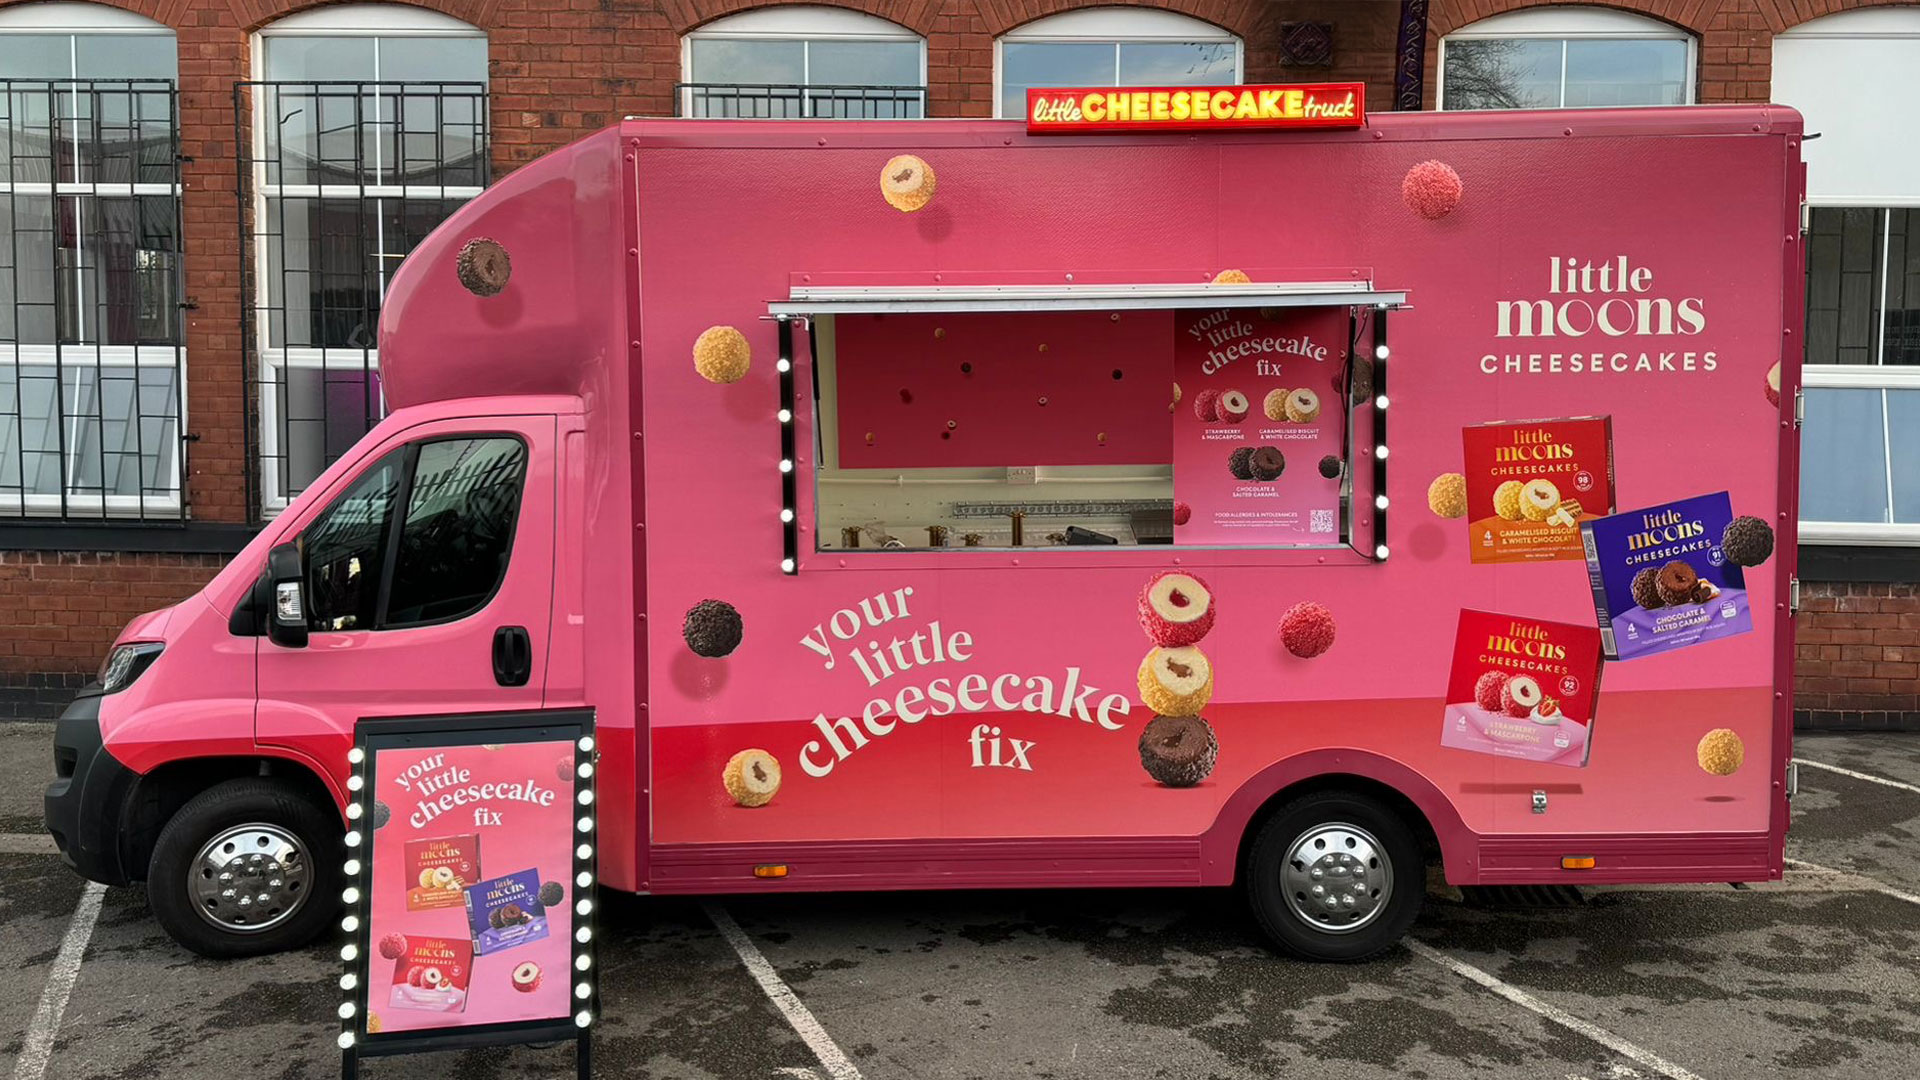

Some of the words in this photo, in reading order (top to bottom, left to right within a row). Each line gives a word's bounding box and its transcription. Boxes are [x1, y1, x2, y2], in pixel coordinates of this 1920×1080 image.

[1033, 97, 1082, 122] little
[1082, 90, 1304, 122] CHEESECAKE
[1304, 92, 1354, 119] truck
[1549, 255, 1652, 293] little
[1188, 308, 1230, 341] your
[1494, 298, 1706, 337] moons
[1207, 321, 1253, 348] little
[1201, 336, 1328, 375] cheesecake
[1256, 359, 1282, 376] fix
[1480, 352, 1717, 374] CHEESECAKES
[1513, 429, 1552, 445] little
[1495, 443, 1574, 462] moons
[1490, 463, 1579, 476] CHEESECAKES
[1642, 509, 1682, 530] little
[1484, 530, 1492, 540] 4
[1500, 528, 1549, 537] CARAMELISED
[1627, 520, 1704, 551] moons
[1625, 538, 1712, 565] CHEESECAKES
[799, 586, 914, 670] your
[1628, 623, 1636, 632] 4
[1652, 623, 1677, 634] SALTED
[1656, 609, 1698, 625] CHOCOLATE
[1509, 621, 1549, 641] little
[849, 620, 973, 687] little
[1487, 635, 1566, 660] moons
[1479, 654, 1568, 675] CHEESECAKES
[799, 667, 1131, 778] cheesecake
[1458, 715, 1466, 725] 4
[968, 723, 1036, 772] fix
[394, 753, 445, 792] your
[416, 765, 471, 797] little
[409, 779, 555, 829] cheesecake
[473, 807, 503, 826] fix
